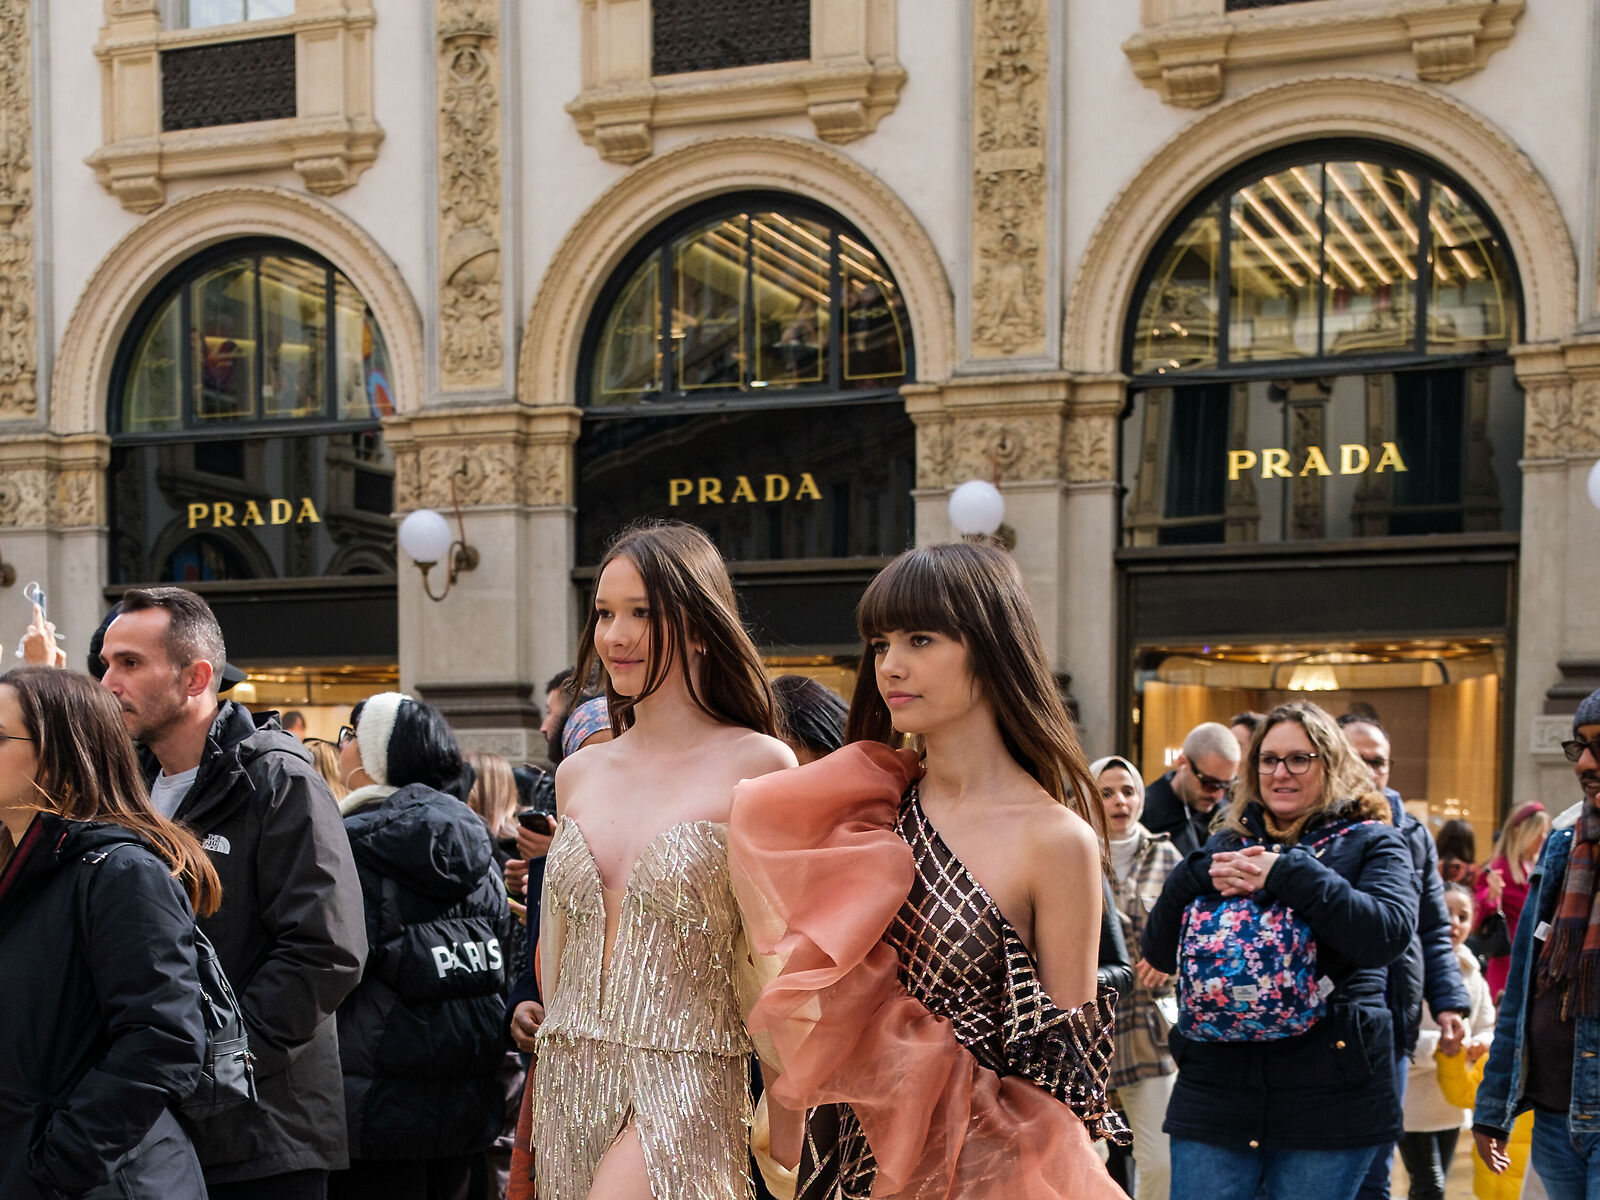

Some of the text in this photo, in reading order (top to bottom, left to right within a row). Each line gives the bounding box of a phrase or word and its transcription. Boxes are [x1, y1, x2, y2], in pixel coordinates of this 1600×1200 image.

[1227, 442, 1409, 480] PRADA
[669, 472, 822, 506] PRADA
[187, 497, 321, 528] PRADA
